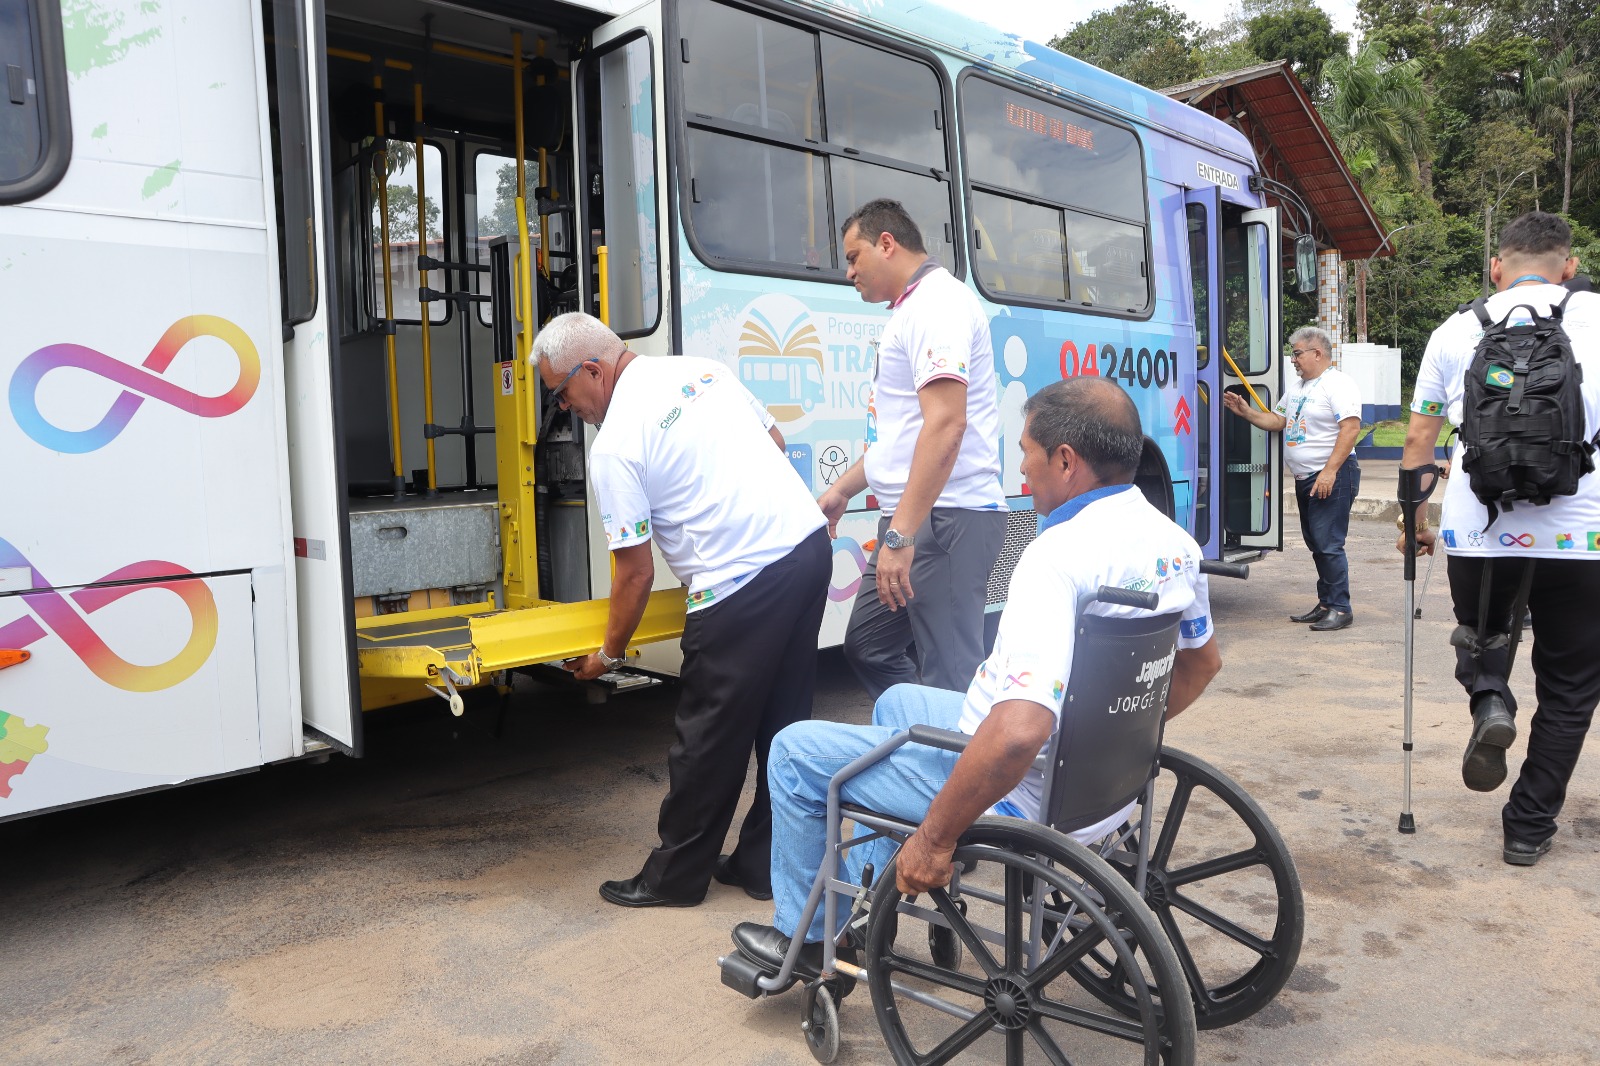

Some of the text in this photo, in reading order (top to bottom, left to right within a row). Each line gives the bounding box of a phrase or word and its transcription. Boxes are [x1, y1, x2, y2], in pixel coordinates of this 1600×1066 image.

[1197, 162, 1239, 190] ENTRADA
[1059, 339, 1178, 390] 0424001
[1108, 690, 1156, 714] JORGE
